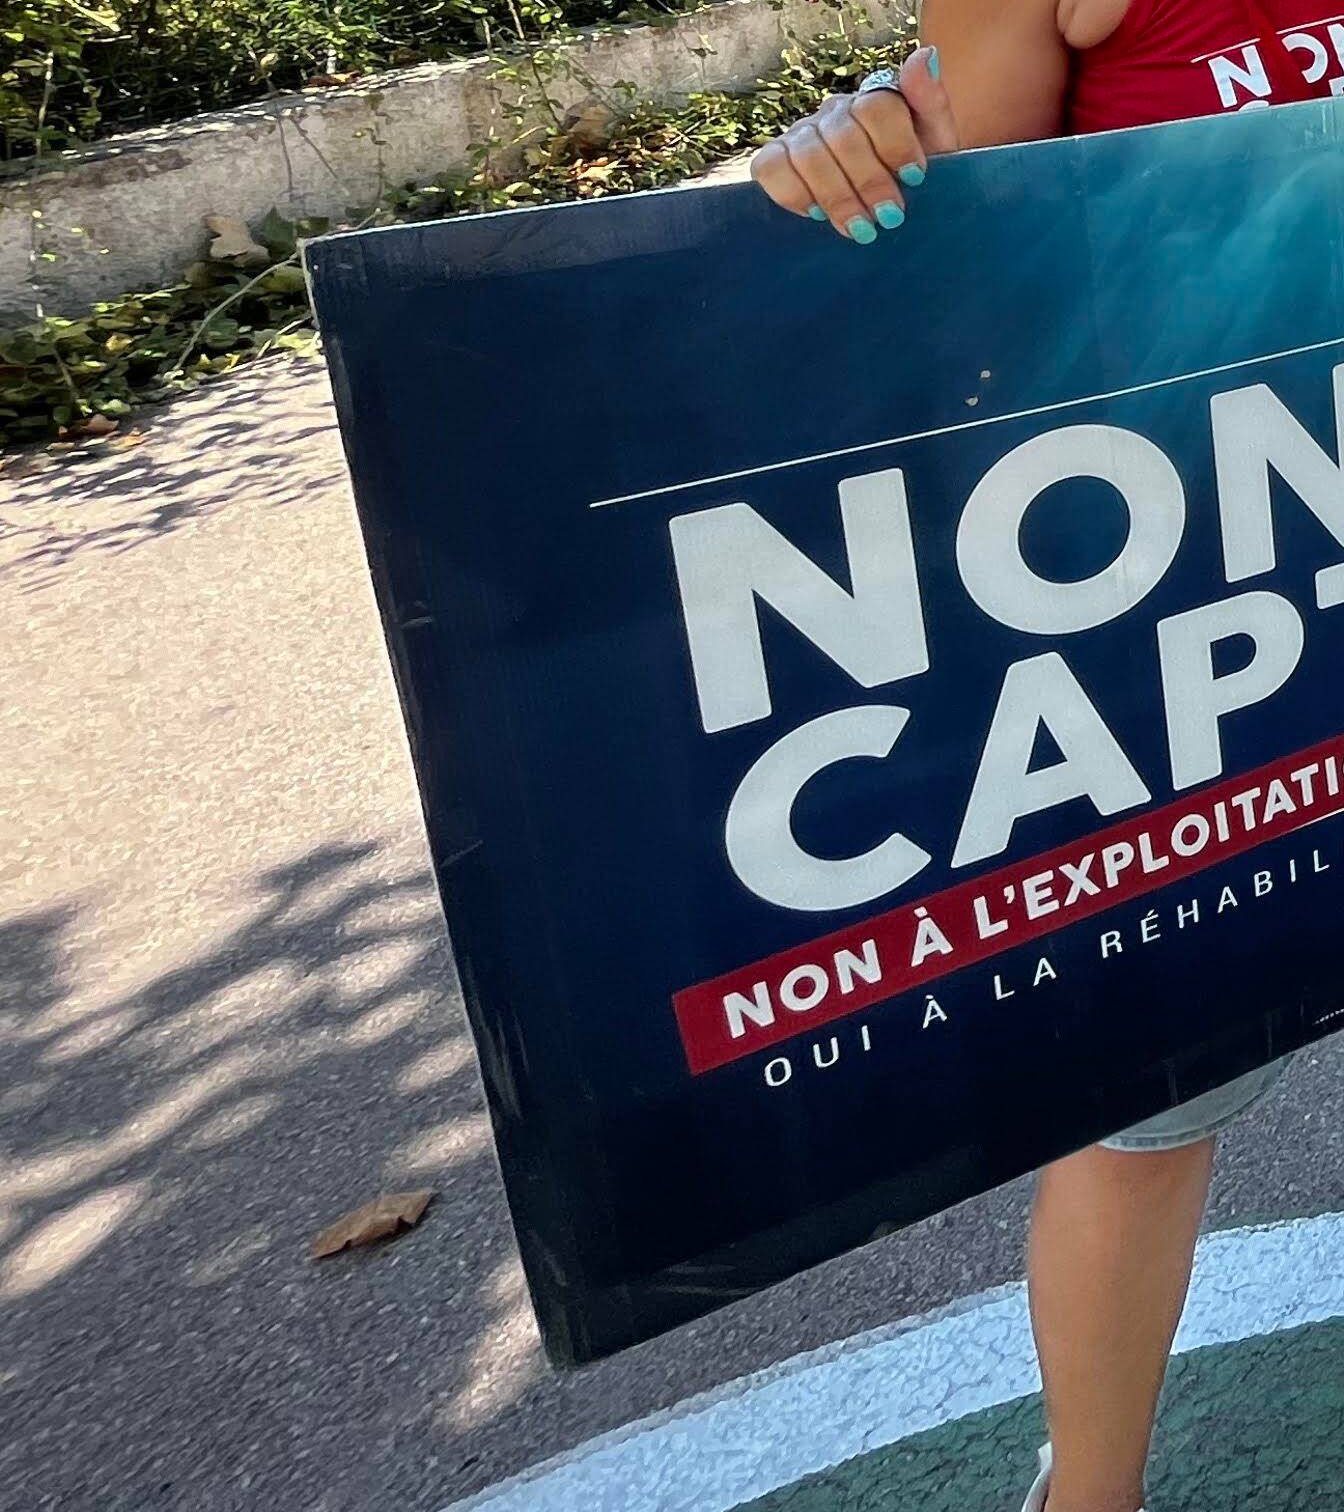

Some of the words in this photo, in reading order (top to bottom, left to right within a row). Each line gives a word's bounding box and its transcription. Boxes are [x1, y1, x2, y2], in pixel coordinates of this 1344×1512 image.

[722, 938, 883, 1040] NON
[910, 905, 955, 968] À
[763, 1024, 872, 1088] OUI
[921, 993, 949, 1029] À
[993, 956, 1058, 1001] LA
